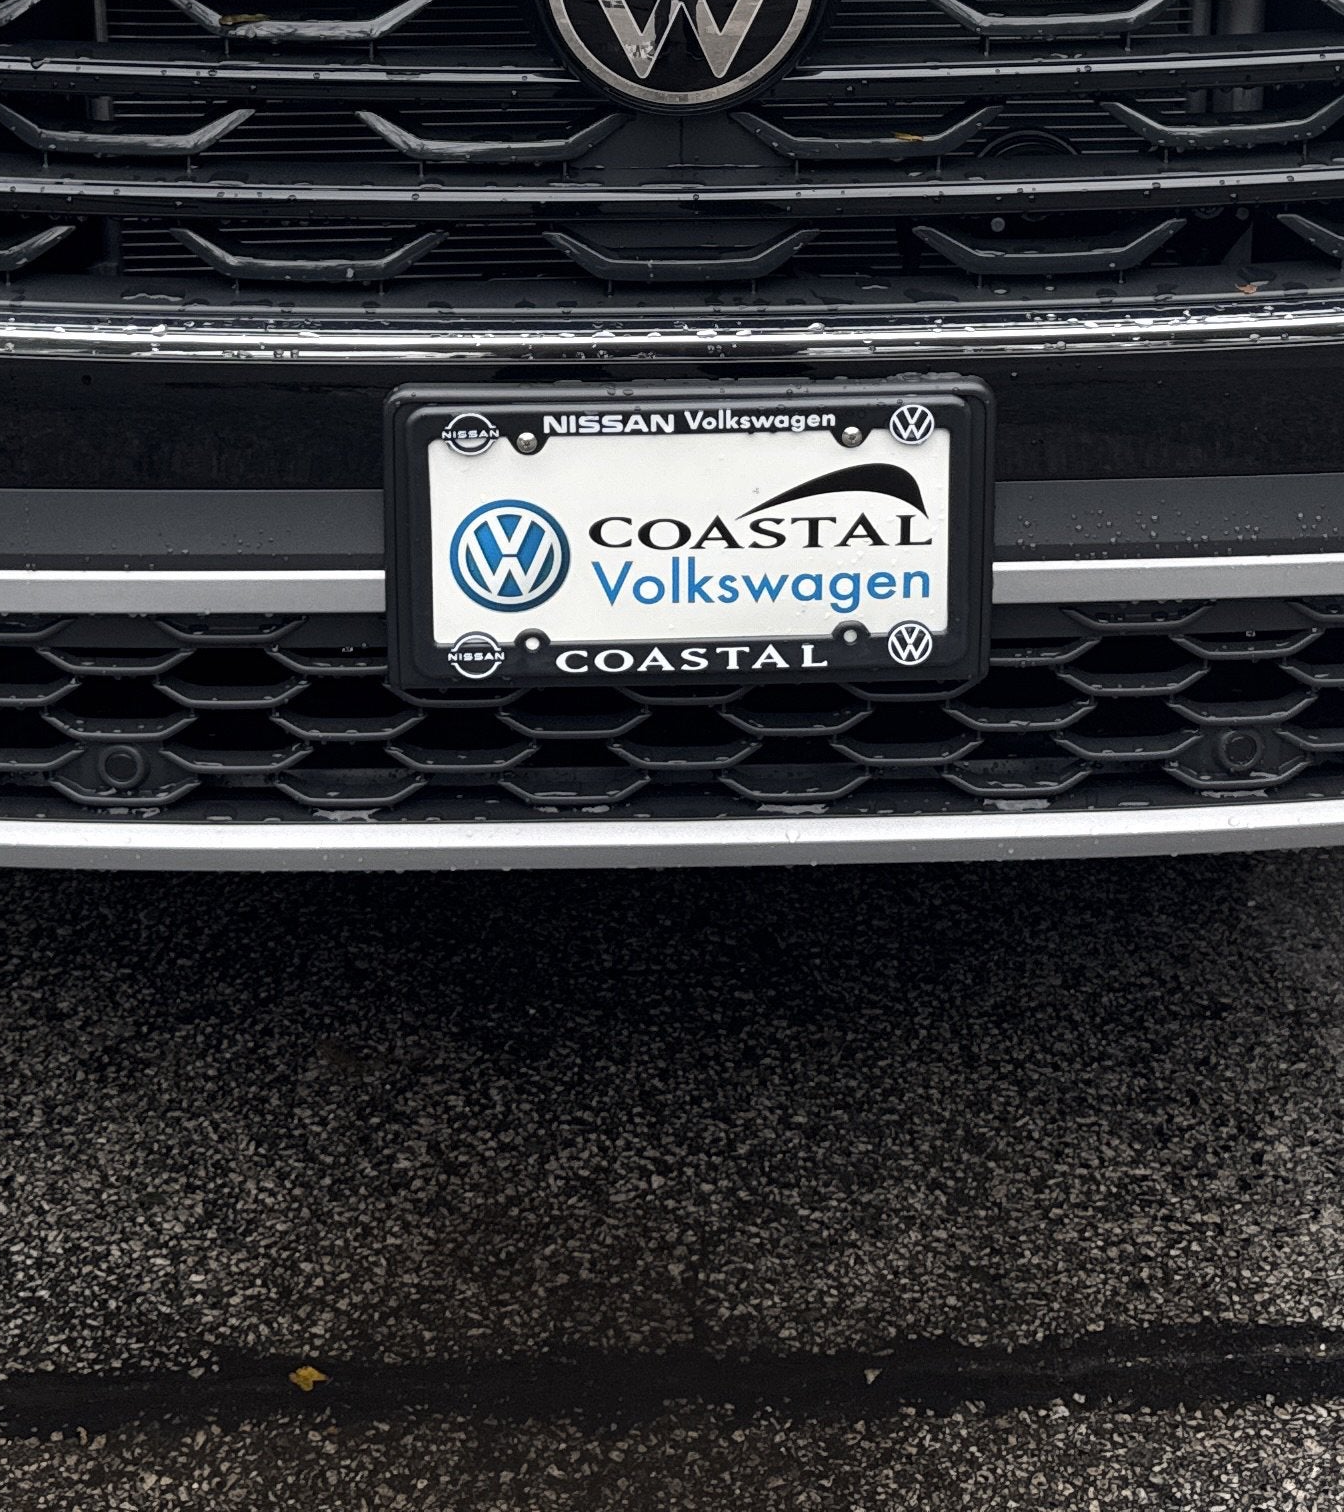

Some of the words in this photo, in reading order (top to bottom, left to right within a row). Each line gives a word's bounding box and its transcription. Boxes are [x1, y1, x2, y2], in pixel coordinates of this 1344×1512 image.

[441, 429, 500, 439] NISSAN
[543, 414, 675, 434] NISSAN
[684, 409, 836, 433] Volkswagen
[588, 512, 933, 551] COASTAL
[461, 511, 558, 600] VW
[591, 556, 931, 614] Volkswagen
[447, 652, 505, 662] NISSAN
[556, 644, 829, 673] COASTAL
